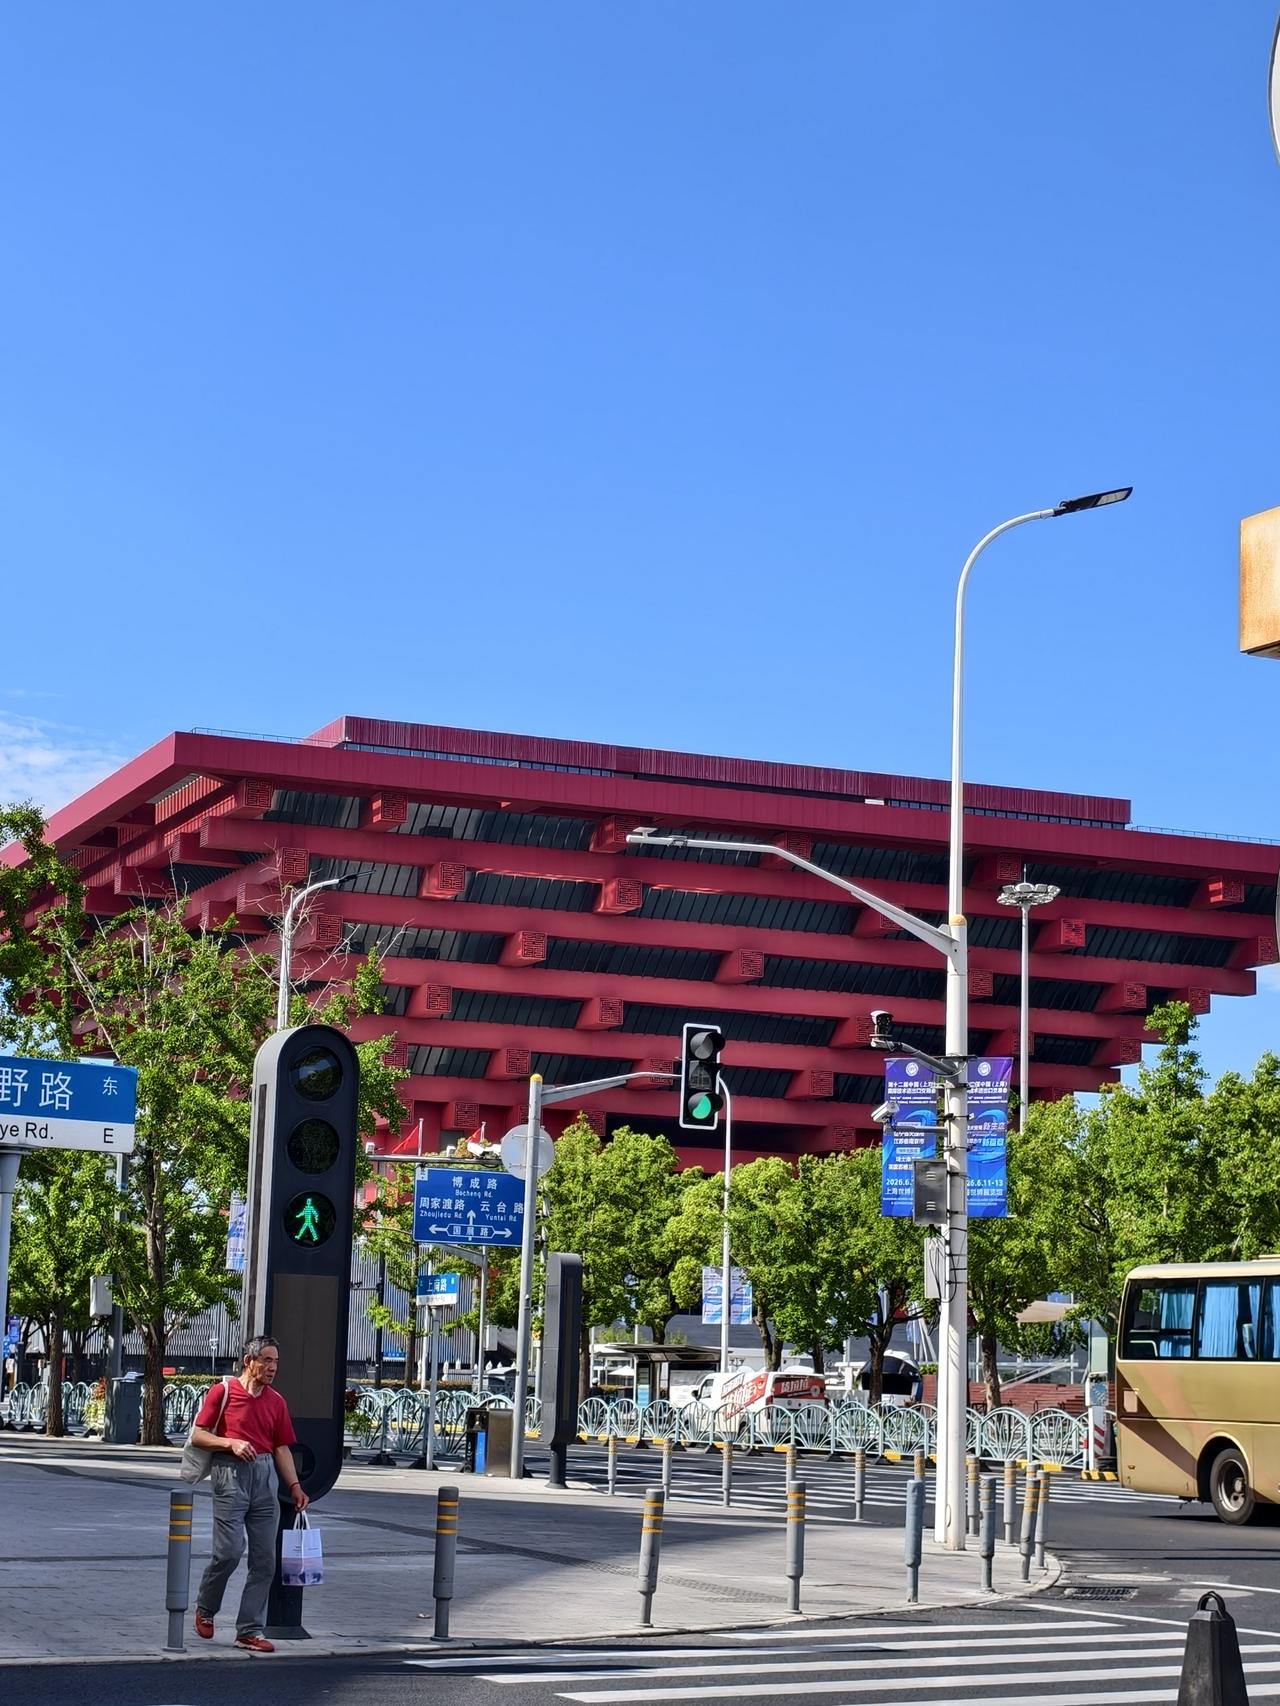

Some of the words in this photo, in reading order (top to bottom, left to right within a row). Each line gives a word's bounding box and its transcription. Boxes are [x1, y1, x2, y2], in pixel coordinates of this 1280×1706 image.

[0, 1067, 73, 1110] 野路
[102, 1076, 118, 1096] 东
[25, 1122, 54, 1140] Rd.
[103, 1127, 114, 1144] E
[452, 1176, 498, 1190] 博成路
[885, 1178, 913, 1186] 2026.6.
[455, 1189, 481, 1199] Bocheng
[884, 1187, 914, 1195] 上海世博
[419, 1197, 465, 1211] 周家渡路
[480, 1200, 524, 1214] 云台路
